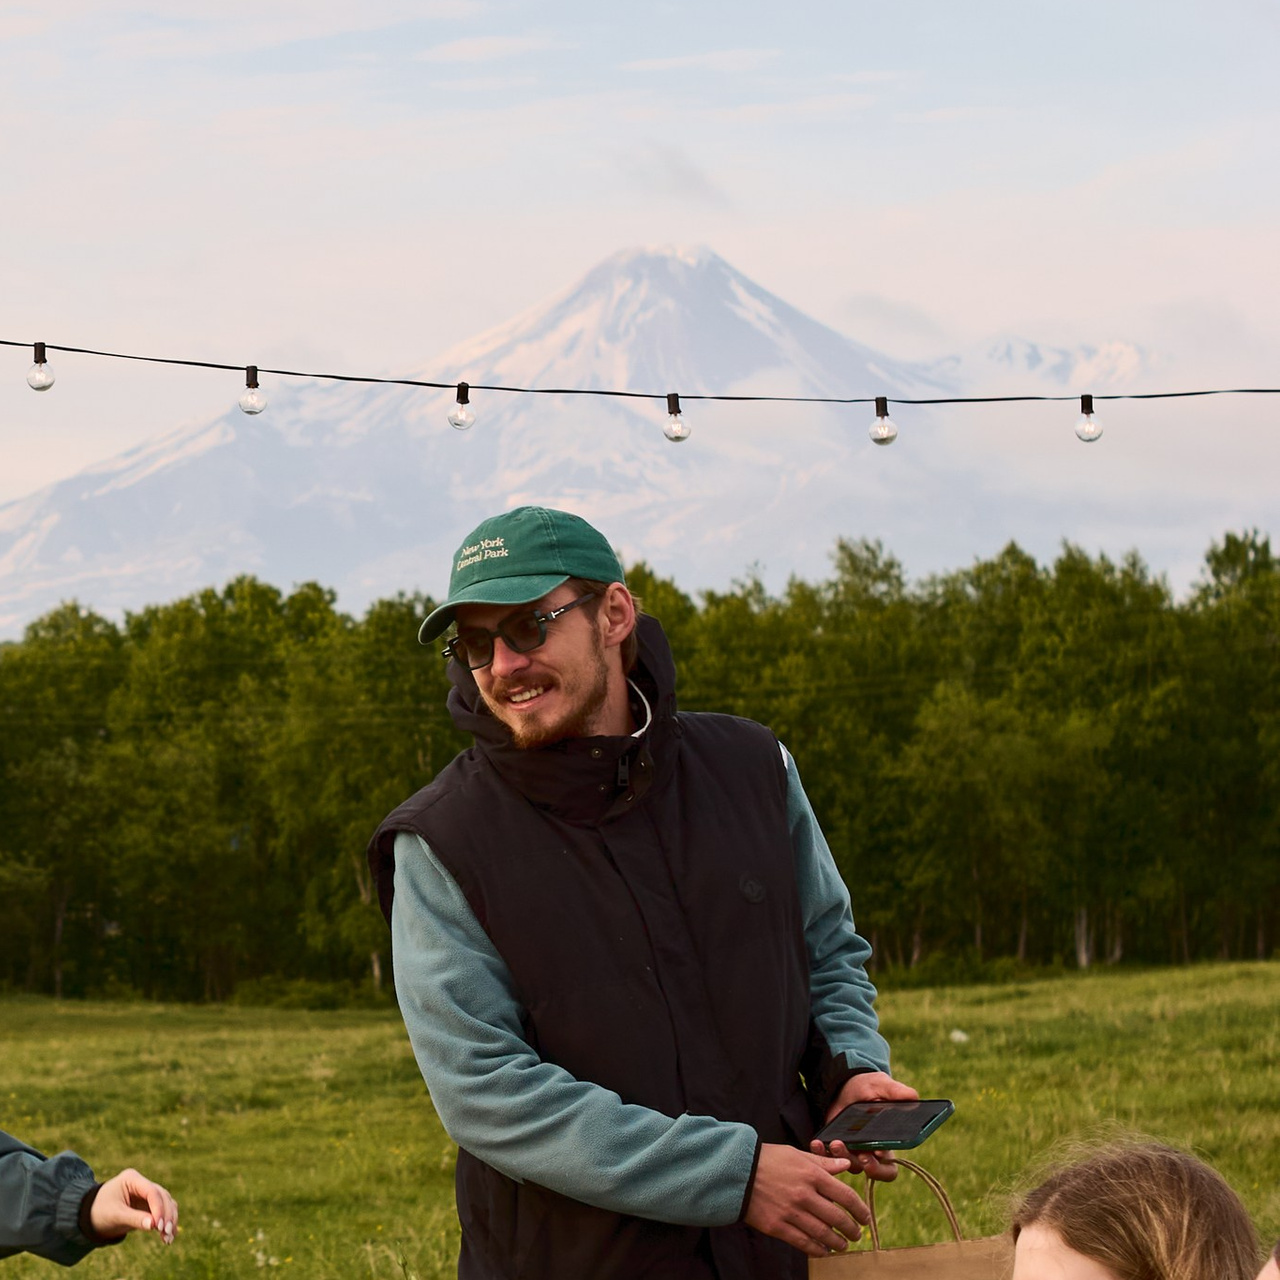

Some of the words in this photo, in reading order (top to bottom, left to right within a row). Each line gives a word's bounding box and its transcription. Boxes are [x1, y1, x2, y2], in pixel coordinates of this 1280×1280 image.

[480, 537, 504, 549] York
[457, 552, 482, 571] Central
[483, 548, 509, 560] Park
